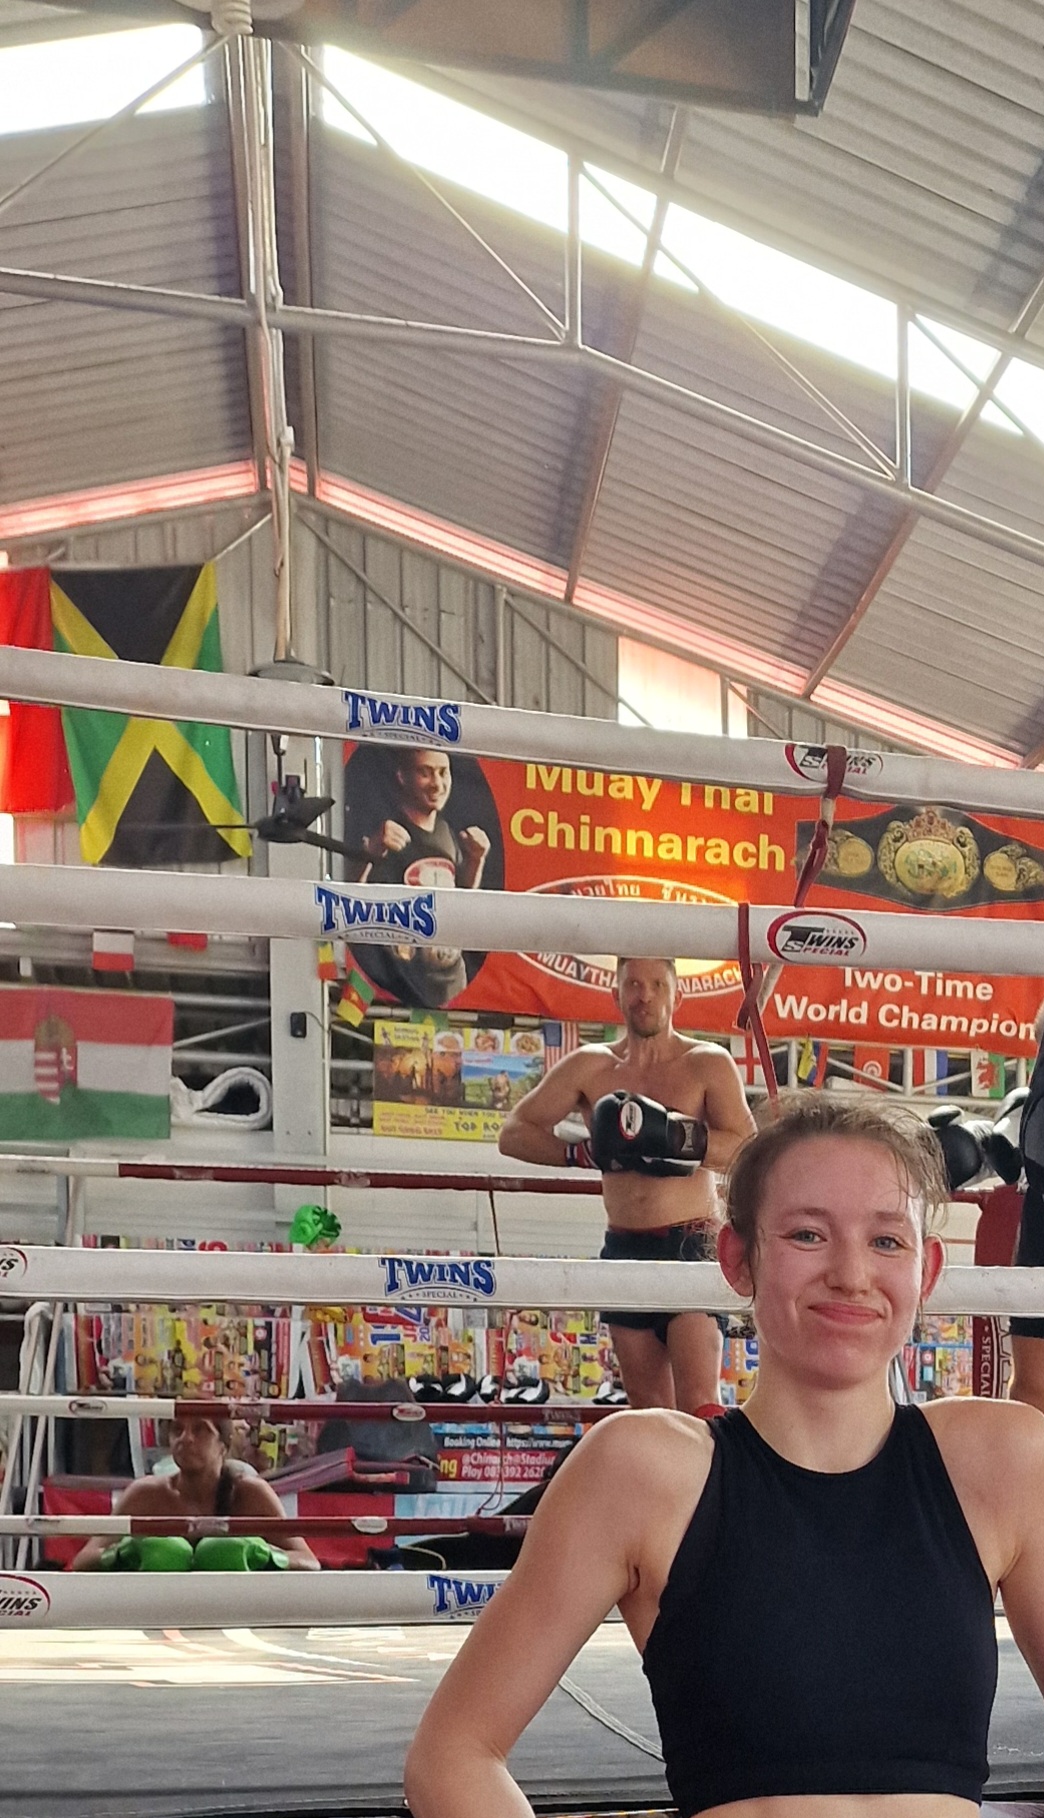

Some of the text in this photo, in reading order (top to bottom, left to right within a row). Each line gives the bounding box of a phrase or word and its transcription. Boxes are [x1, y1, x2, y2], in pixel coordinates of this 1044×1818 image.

[344, 691, 460, 743] TWINS
[525, 763, 662, 811] Muay
[510, 808, 786, 872] Chinnarach
[316, 886, 437, 939] TWINS
[840, 965, 994, 1002] Two-Time
[774, 992, 1036, 1042] World Champion
[381, 1257, 496, 1297] TWINS
